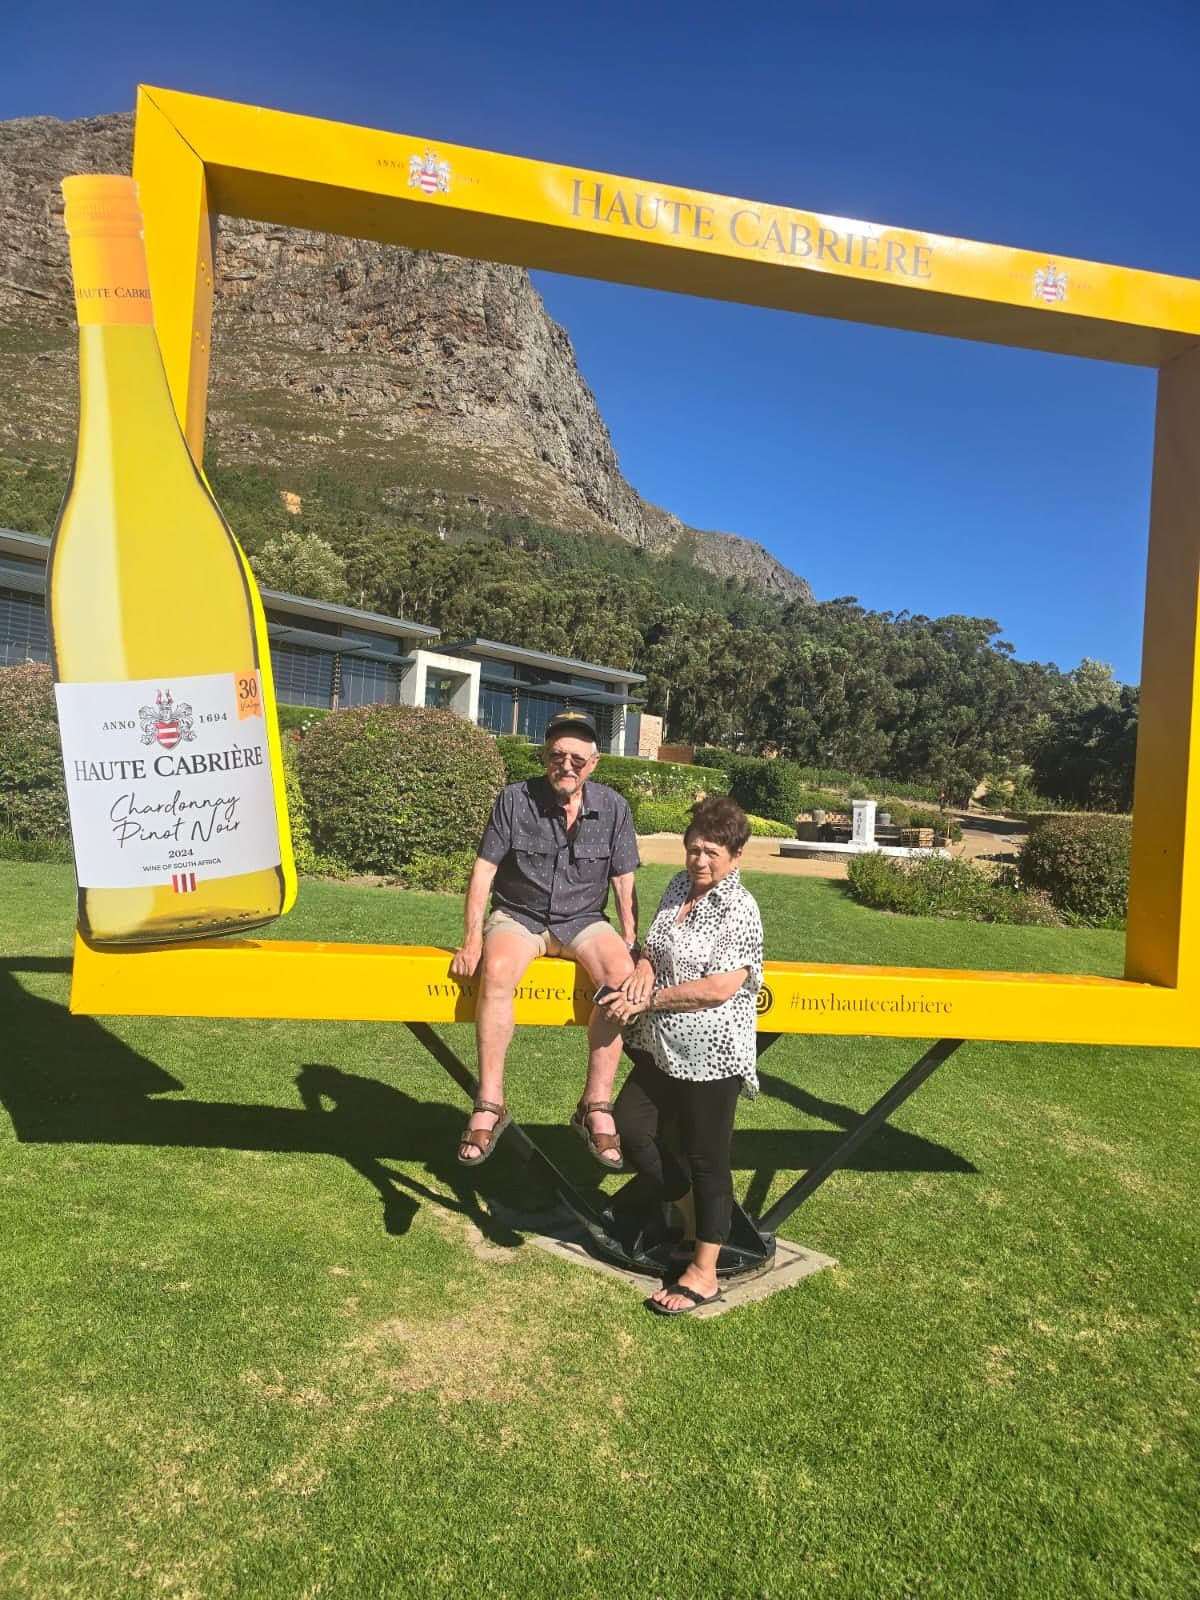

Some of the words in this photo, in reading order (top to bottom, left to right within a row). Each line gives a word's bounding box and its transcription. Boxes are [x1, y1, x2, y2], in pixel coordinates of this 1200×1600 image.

[570, 178, 715, 241] HAUTE
[239, 678, 257, 699] 30
[102, 720, 136, 731] ANNO
[199, 712, 228, 724] 1694
[74, 760, 147, 782] HAUTE
[153, 743, 263, 777] CABRIÈRE
[110, 790, 241, 823] Chardonnay
[112, 817, 184, 848] Pinot
[191, 806, 241, 842] Noir
[162, 863, 172, 871] OF
[173, 860, 197, 870] SOUTH
[197, 857, 221, 867] AFRICA
[168, 848, 194, 859] 2024
[790, 991, 953, 1016] #myhautecabriere
